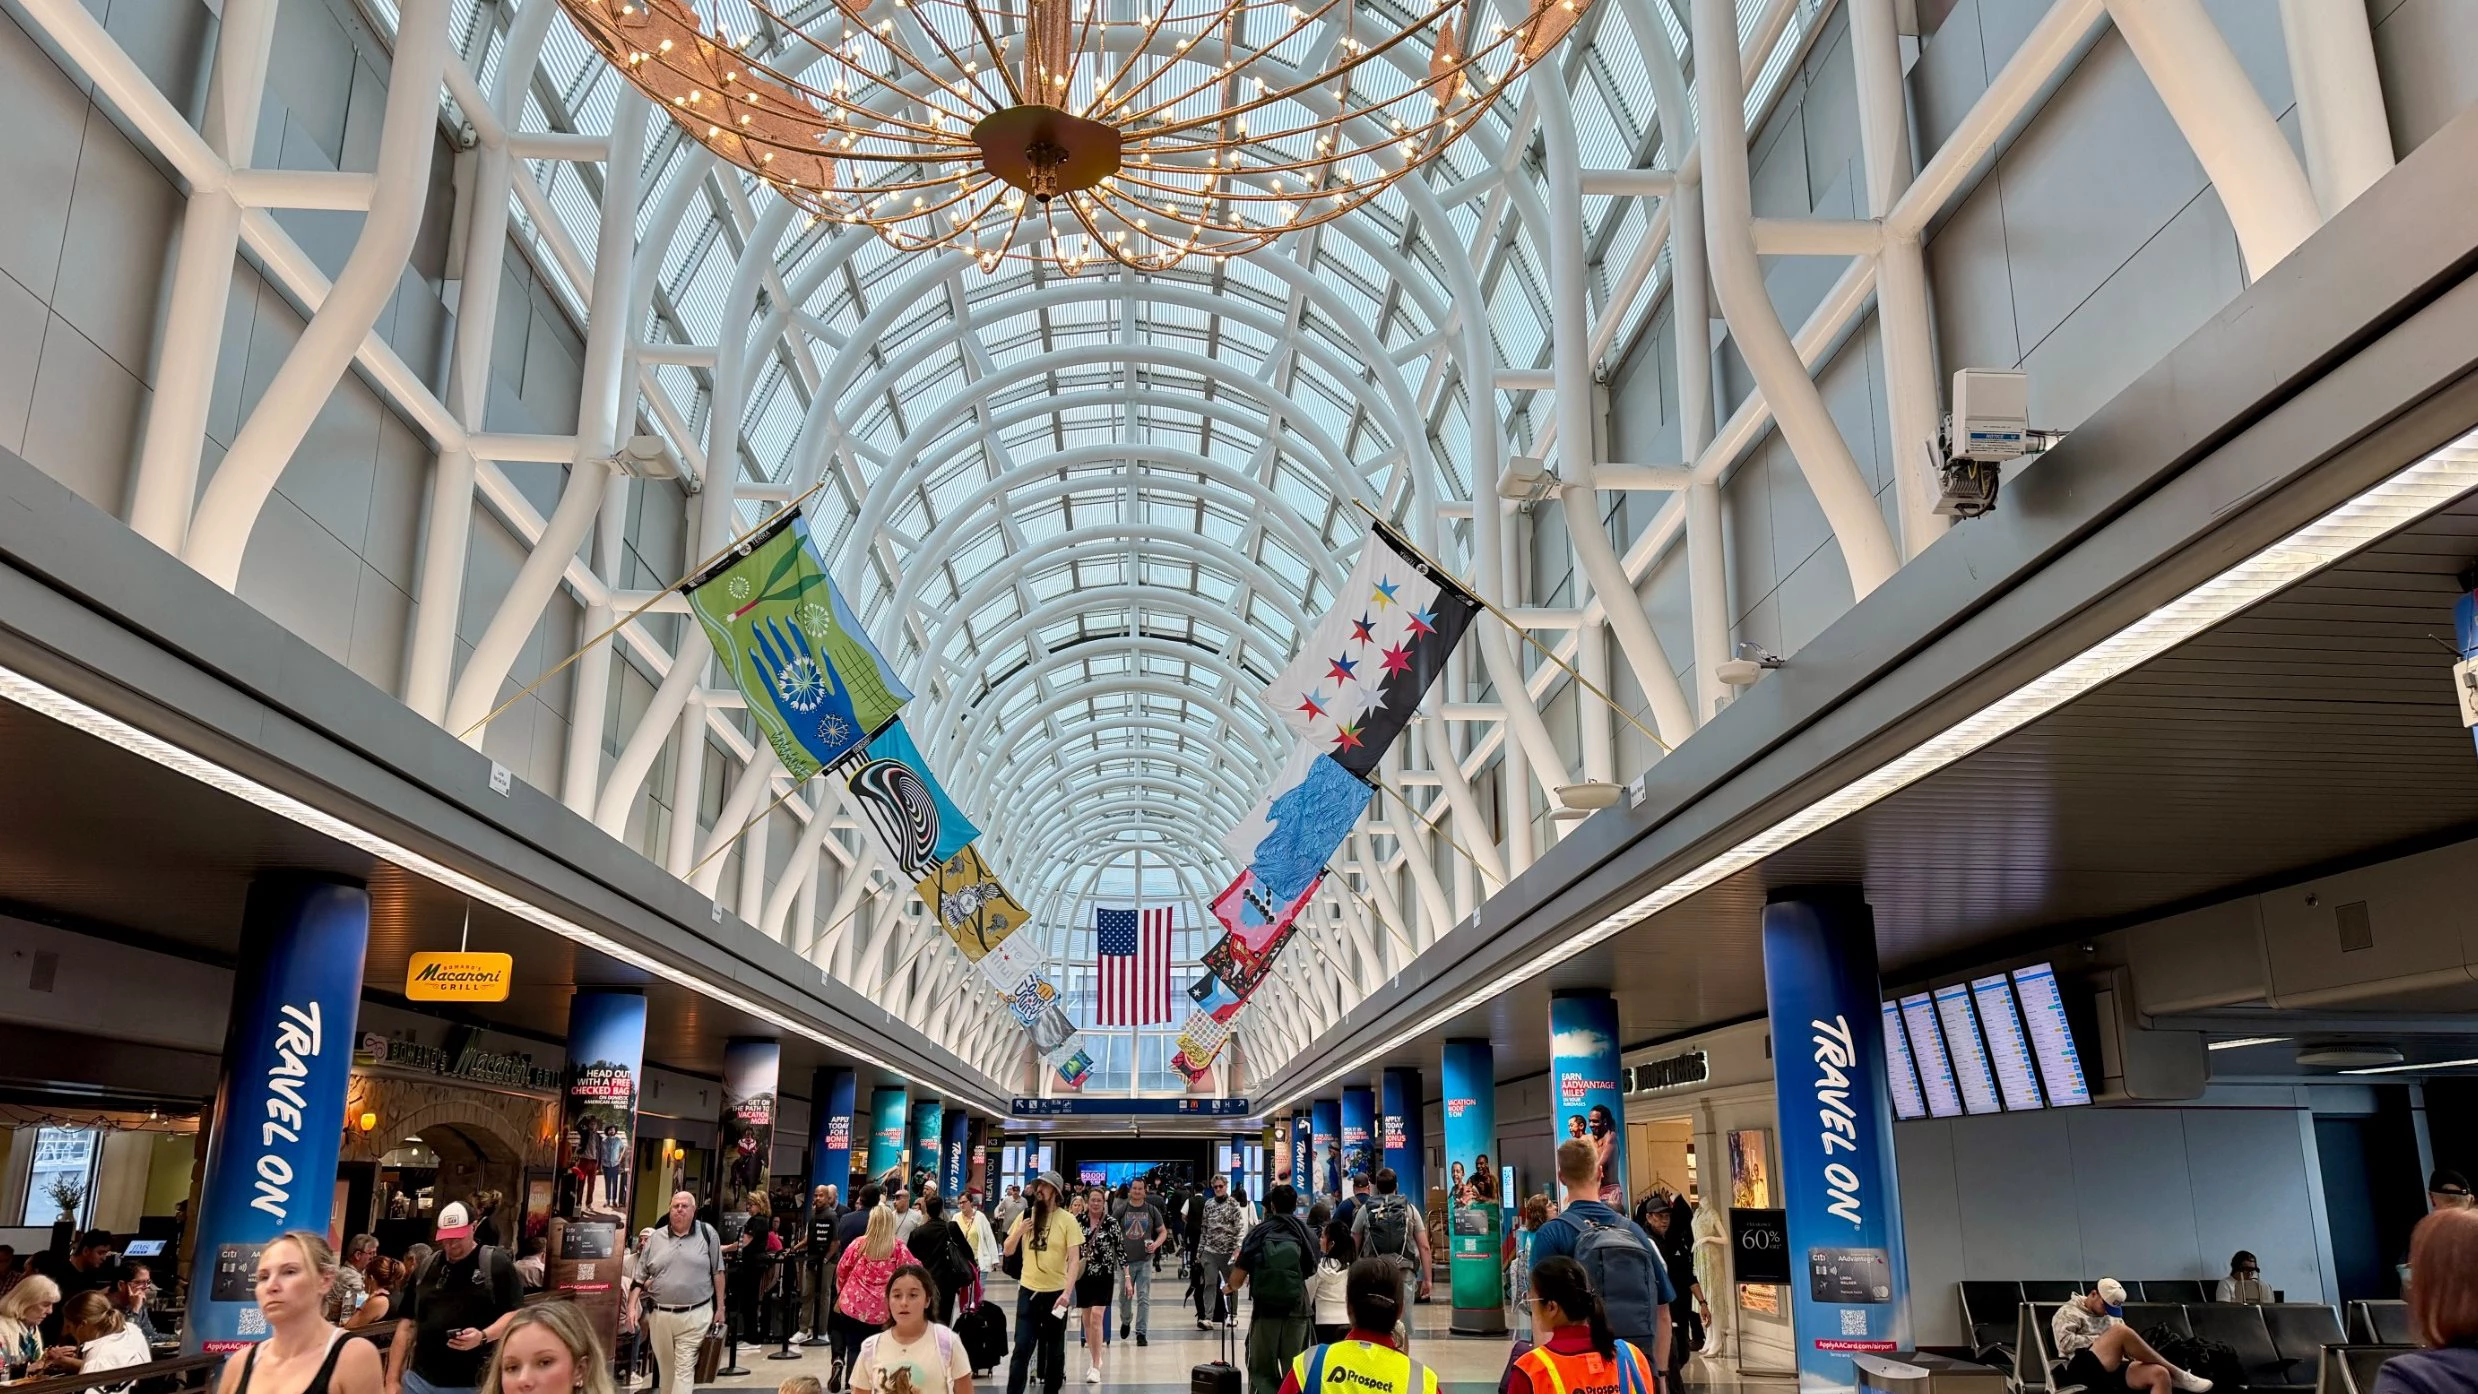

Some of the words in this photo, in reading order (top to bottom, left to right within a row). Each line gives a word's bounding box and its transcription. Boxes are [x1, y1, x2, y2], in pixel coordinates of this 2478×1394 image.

[415, 963, 501, 982] Macaroni
[440, 983, 479, 991] GRILL
[263, 1001, 321, 1146] TRAVEL
[586, 1069, 613, 1078] HEAD
[614, 1070, 631, 1078] OUT
[577, 1078, 601, 1086] WITH
[602, 1078, 610, 1086] A
[611, 1079, 630, 1087] FREE
[1561, 1081, 1616, 1089] AADVANTAGE
[1811, 1015, 1856, 1155] TRAVEL
[571, 1086, 611, 1095] CHECKED
[612, 1087, 630, 1096] BAG
[1563, 1089, 1585, 1097] MILES
[951, 1141, 962, 1176] TRAVEL
[1296, 1140, 1307, 1173] TRAVEL
[987, 1158, 995, 1177] YOU
[949, 1177, 958, 1192] ON
[1297, 1176, 1305, 1190] ON
[1742, 1229, 1781, 1250] 60%
[1819, 1341, 1893, 1351] ApplyAACard.com/airport
[1347, 1370, 1393, 1393] Prospect
